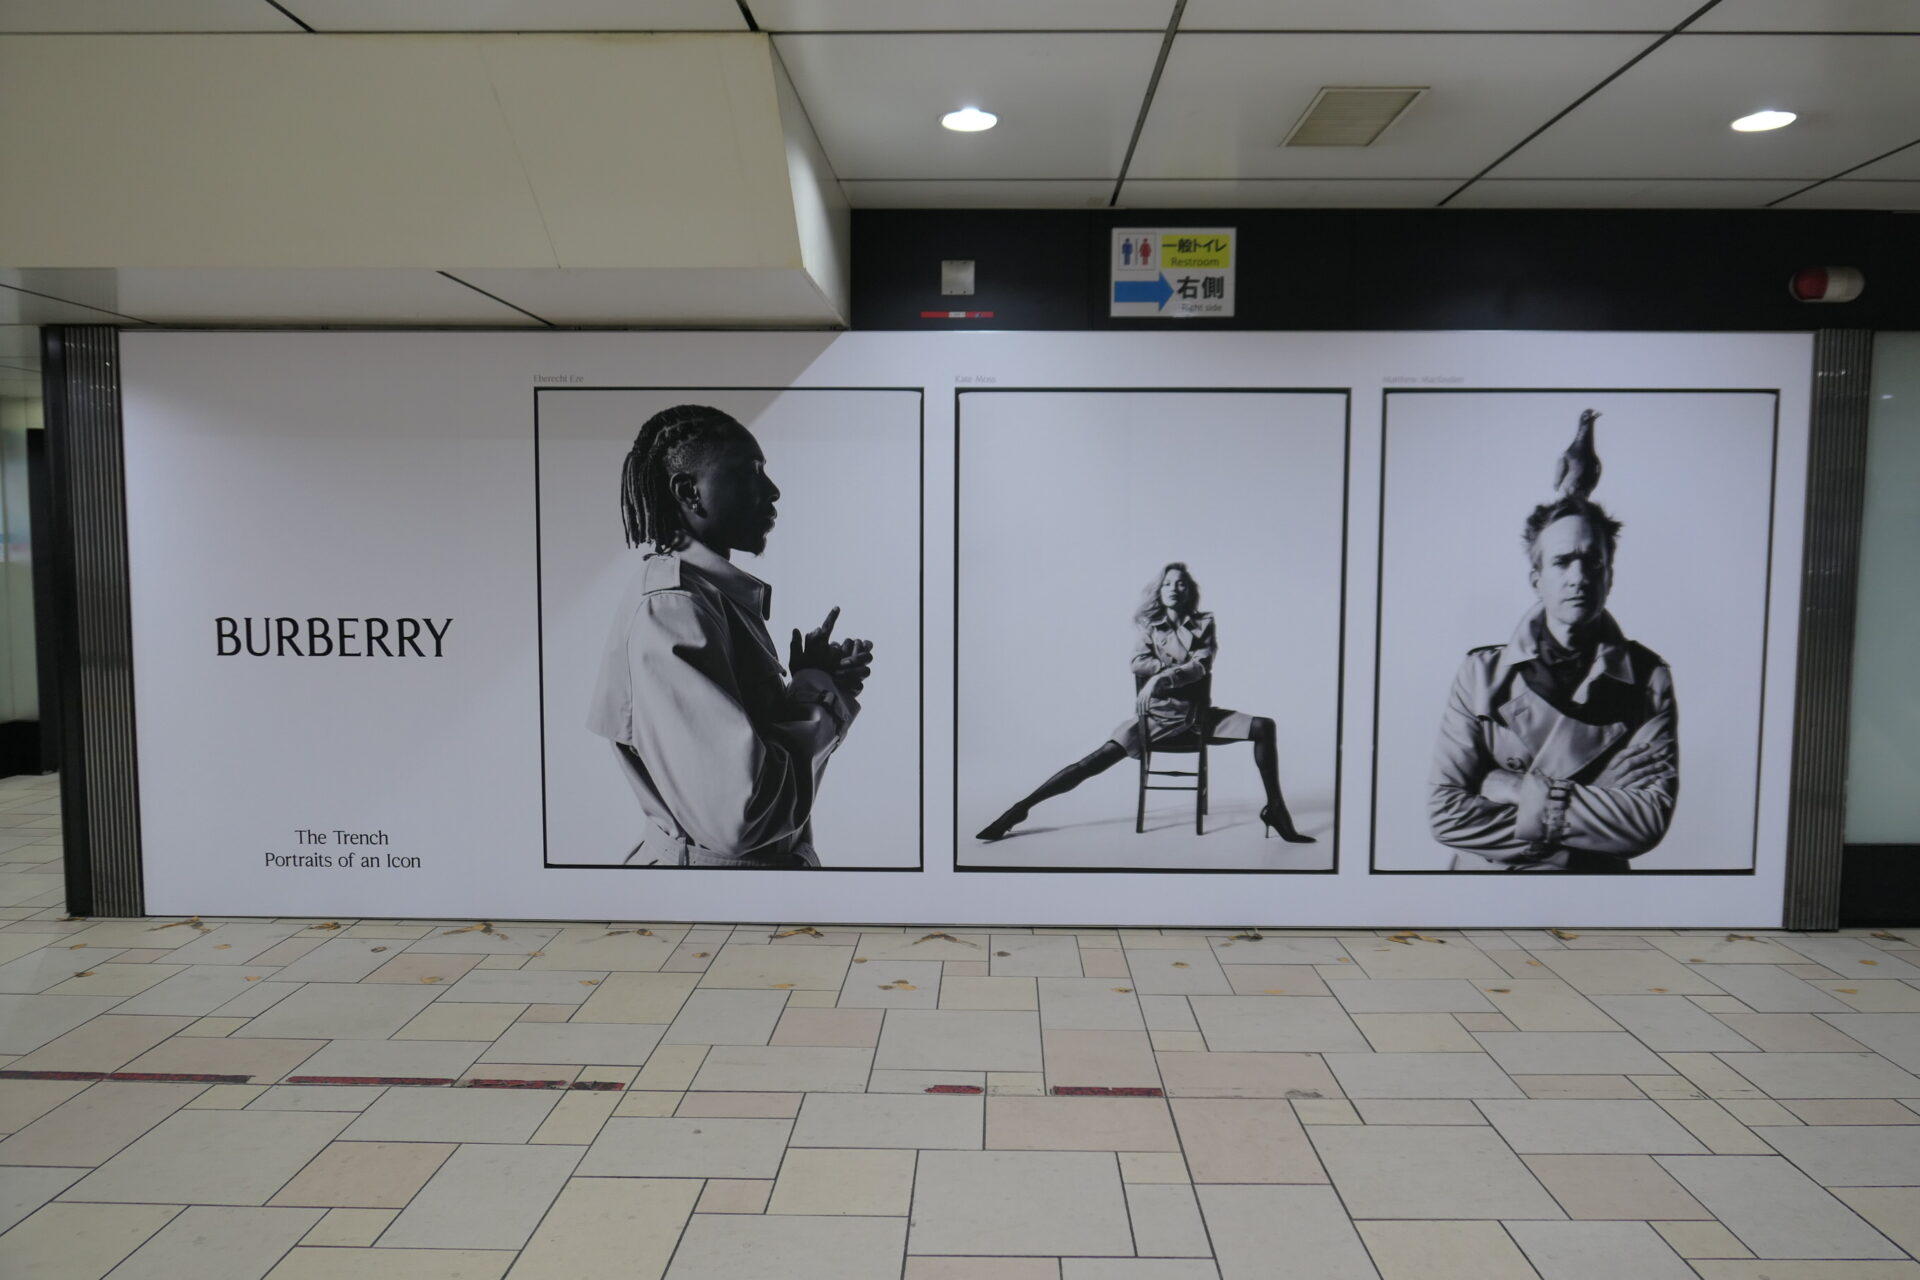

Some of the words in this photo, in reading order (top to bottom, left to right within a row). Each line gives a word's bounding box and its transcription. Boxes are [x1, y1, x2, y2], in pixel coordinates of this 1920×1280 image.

[1162, 238, 1227, 253] 一般トイレ
[1171, 257, 1220, 267] Restroom
[1176, 276, 1225, 299] 右側
[1205, 303, 1223, 312] side
[215, 616, 454, 657] BURBERRY
[294, 829, 327, 845] The
[333, 829, 389, 845] Trench
[265, 852, 332, 867] Portraits
[338, 852, 356, 868] of
[361, 856, 380, 868] an
[387, 853, 421, 868] Icon
